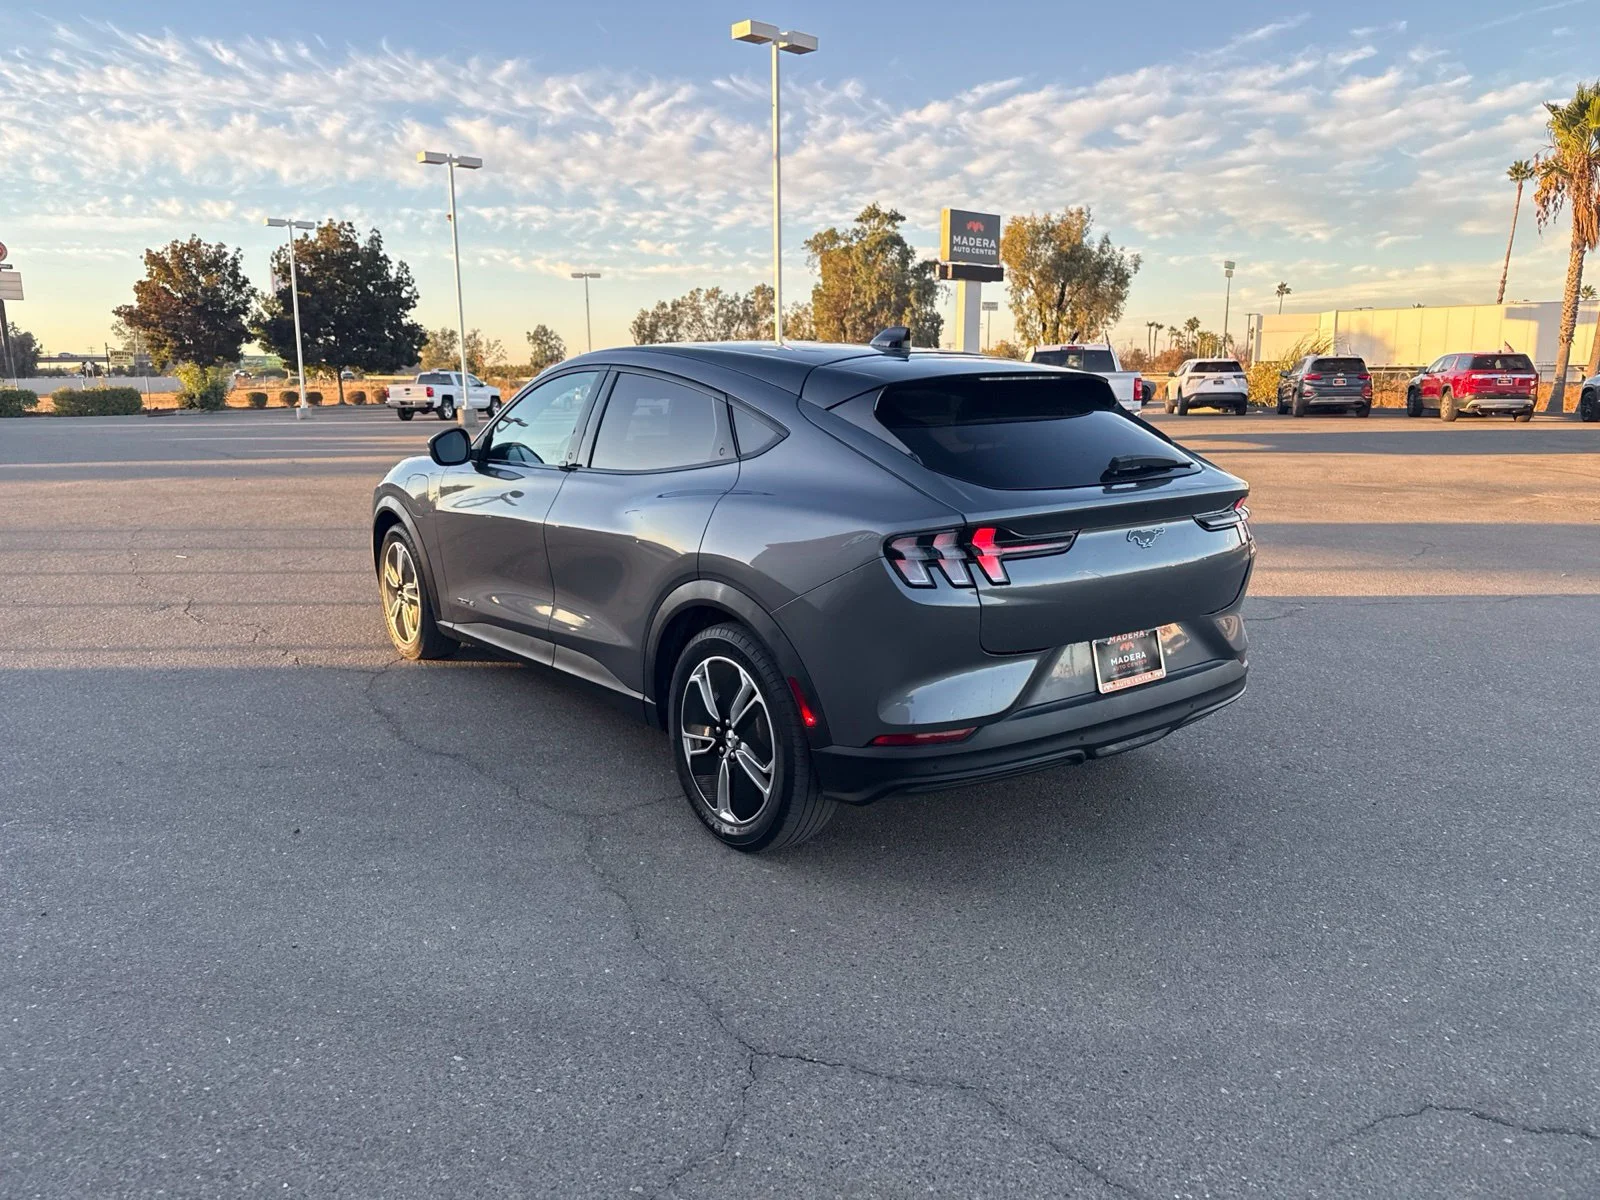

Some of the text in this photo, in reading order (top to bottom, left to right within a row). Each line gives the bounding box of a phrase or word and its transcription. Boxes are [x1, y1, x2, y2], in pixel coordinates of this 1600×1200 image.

[953, 235, 996, 248] MADERA
[971, 247, 996, 255] CENTER
[1109, 631, 1144, 643] MADERA
[1111, 652, 1146, 666] MADERA
[1127, 660, 1147, 668] CENTER
[1116, 674, 1152, 687] AUTO CENTER
